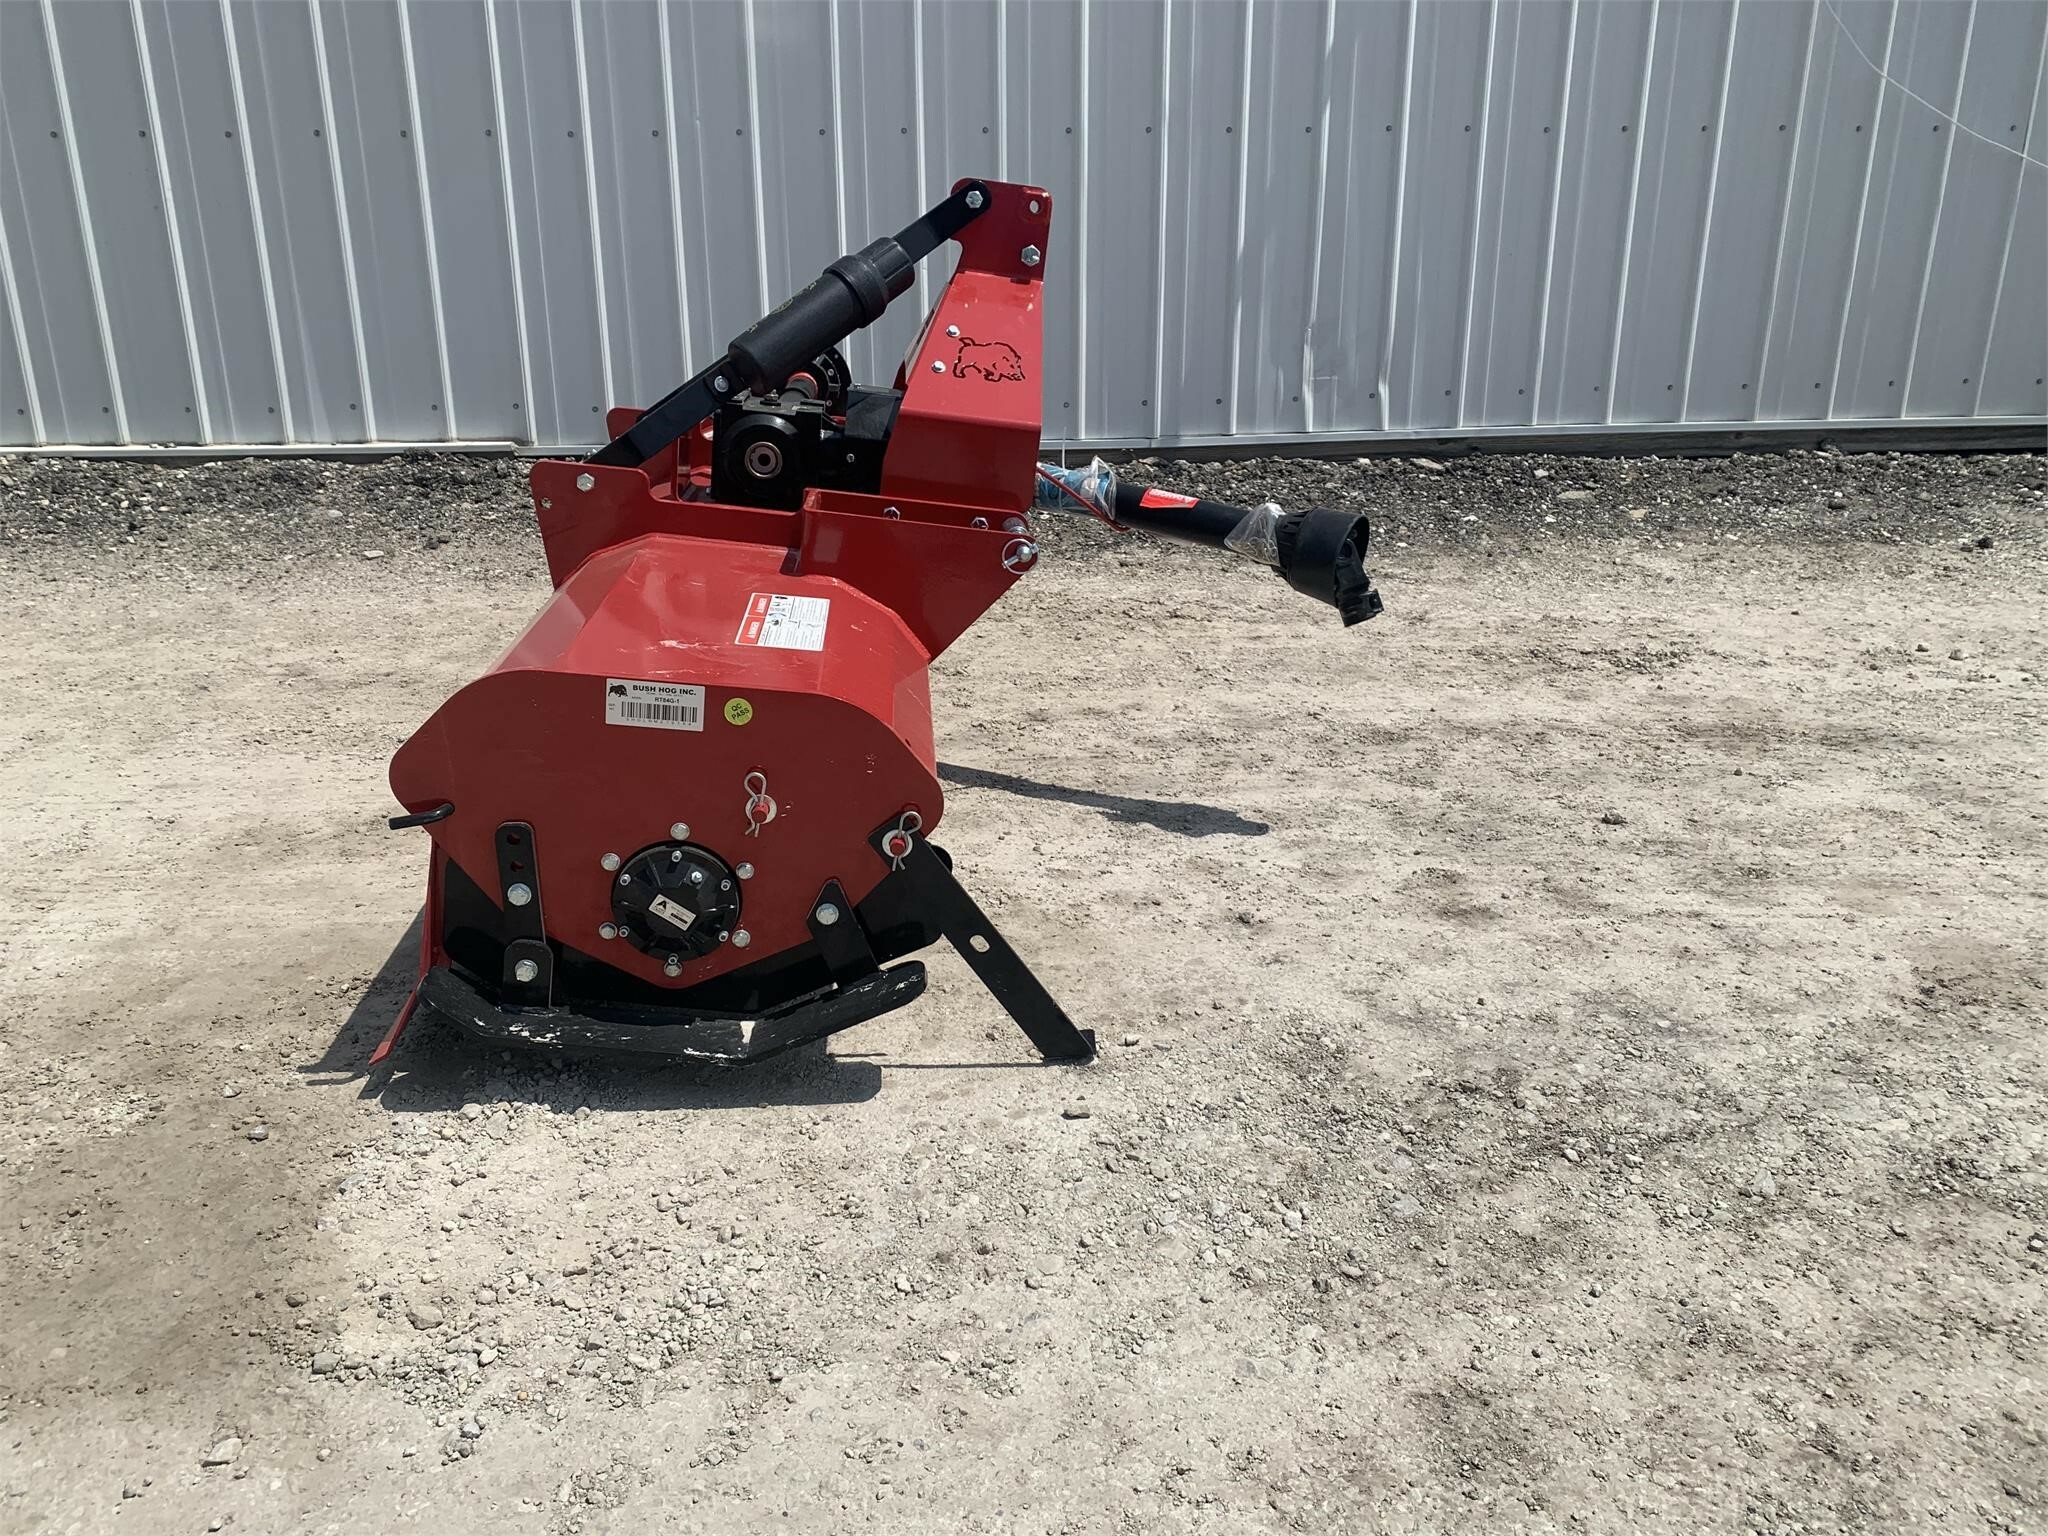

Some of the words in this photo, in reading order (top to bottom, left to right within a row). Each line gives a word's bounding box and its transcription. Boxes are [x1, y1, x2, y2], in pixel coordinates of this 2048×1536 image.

[632, 684, 656, 693] BUSH
[679, 688, 697, 696] INC.
[731, 703, 742, 712] QC
[731, 707, 750, 720] PASS
